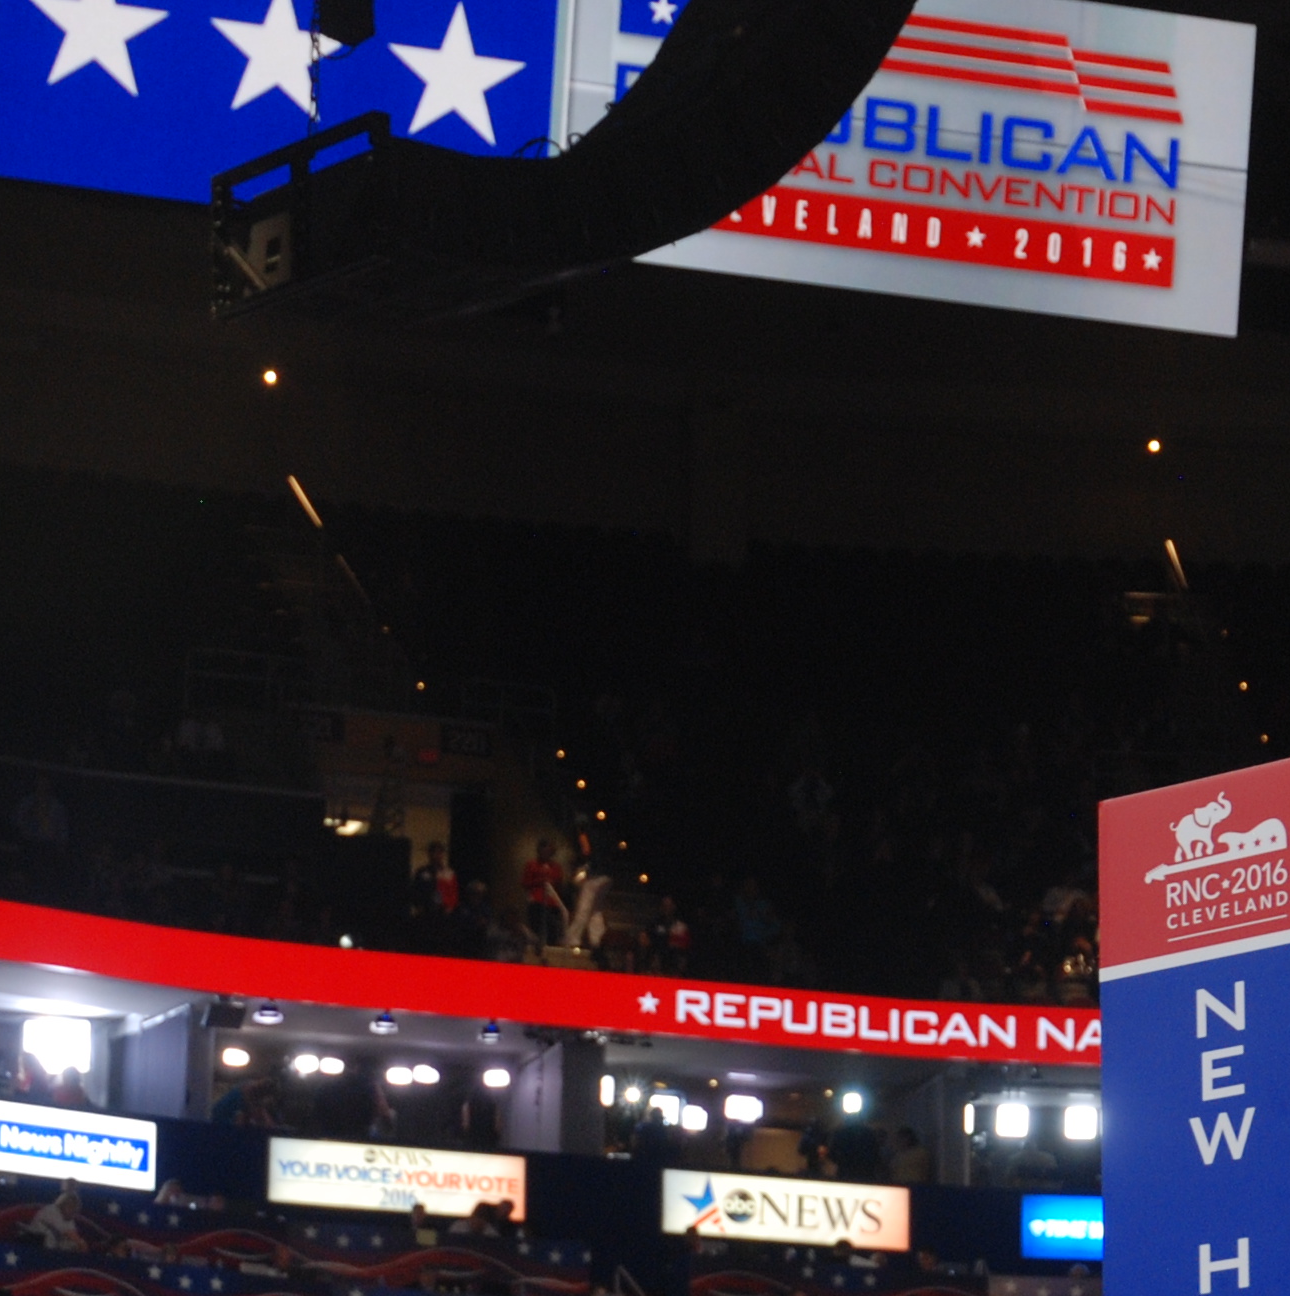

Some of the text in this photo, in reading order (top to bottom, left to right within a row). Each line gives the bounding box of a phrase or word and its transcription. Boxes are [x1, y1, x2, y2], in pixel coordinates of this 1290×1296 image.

[868, 158, 1176, 225] CONVENTION
[729, 194, 1128, 272] VELAND 2016
[1165, 859, 1289, 908] RNC 2016
[1166, 890, 1289, 930] CLEVELAND
[674, 989, 1016, 1048] REPUBLICAN
[1189, 980, 1256, 1165] NEW
[278, 1159, 521, 1195] YOUR VOICE YOUR VOTE
[758, 1194, 883, 1234] NEWS
